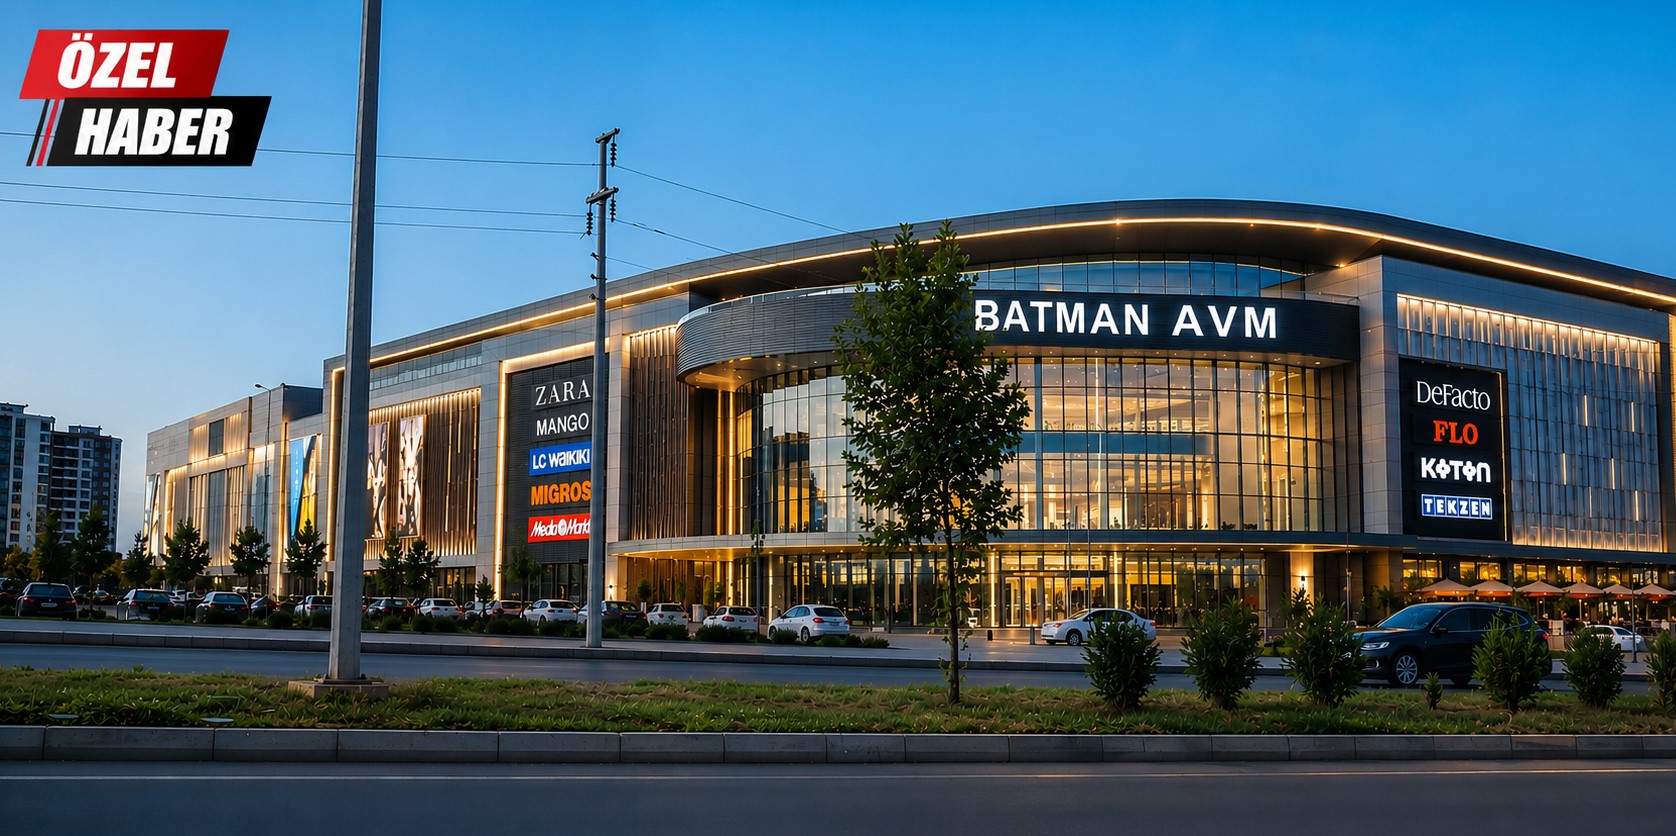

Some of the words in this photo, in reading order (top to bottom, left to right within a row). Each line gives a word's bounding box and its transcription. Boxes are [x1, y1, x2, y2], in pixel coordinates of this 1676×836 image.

[974, 299, 1149, 336] BATMAN
[1171, 304, 1277, 339] AVM
[535, 379, 591, 406] ZARA
[1416, 380, 1491, 411] DeFacto
[536, 412, 589, 437] MANGO
[1433, 420, 1479, 445] FLO
[532, 453, 547, 470] LC
[530, 480, 592, 506] MIGROS
[1424, 497, 1491, 517] TEKZEN
